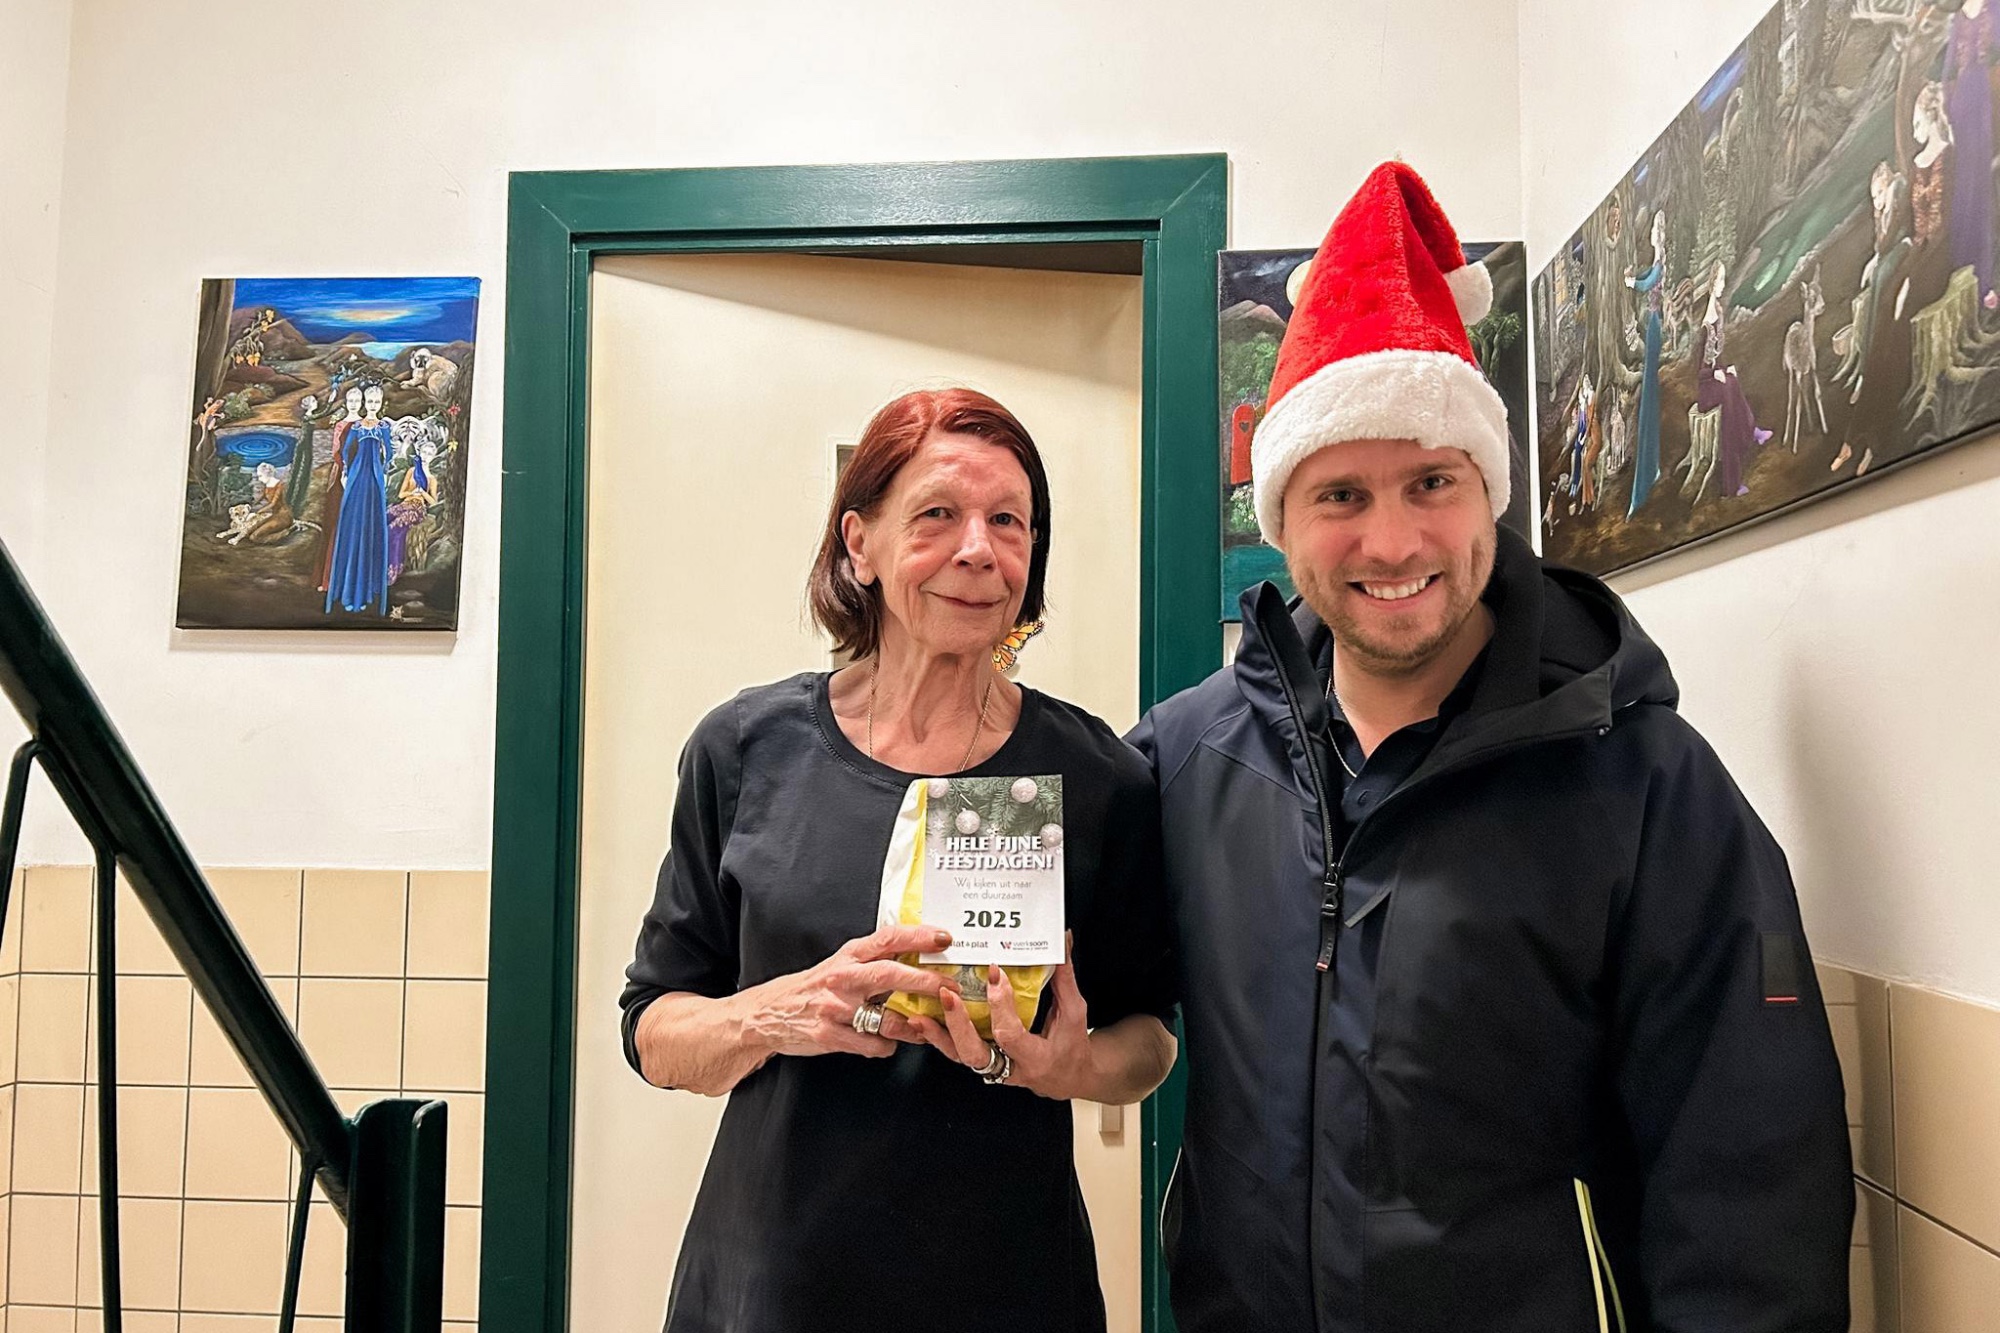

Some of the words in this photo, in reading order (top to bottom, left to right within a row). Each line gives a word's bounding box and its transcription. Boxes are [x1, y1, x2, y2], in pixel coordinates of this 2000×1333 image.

[946, 836, 989, 851] HELE
[995, 835, 1042, 854] FIJNE
[935, 854, 1054, 870] FEESTDAGEN!
[954, 877, 971, 889] Wij
[974, 877, 997, 889] kijken
[1000, 880, 1011, 888] uit
[981, 889, 1023, 900] duurzaam
[963, 910, 1022, 928] 2025
